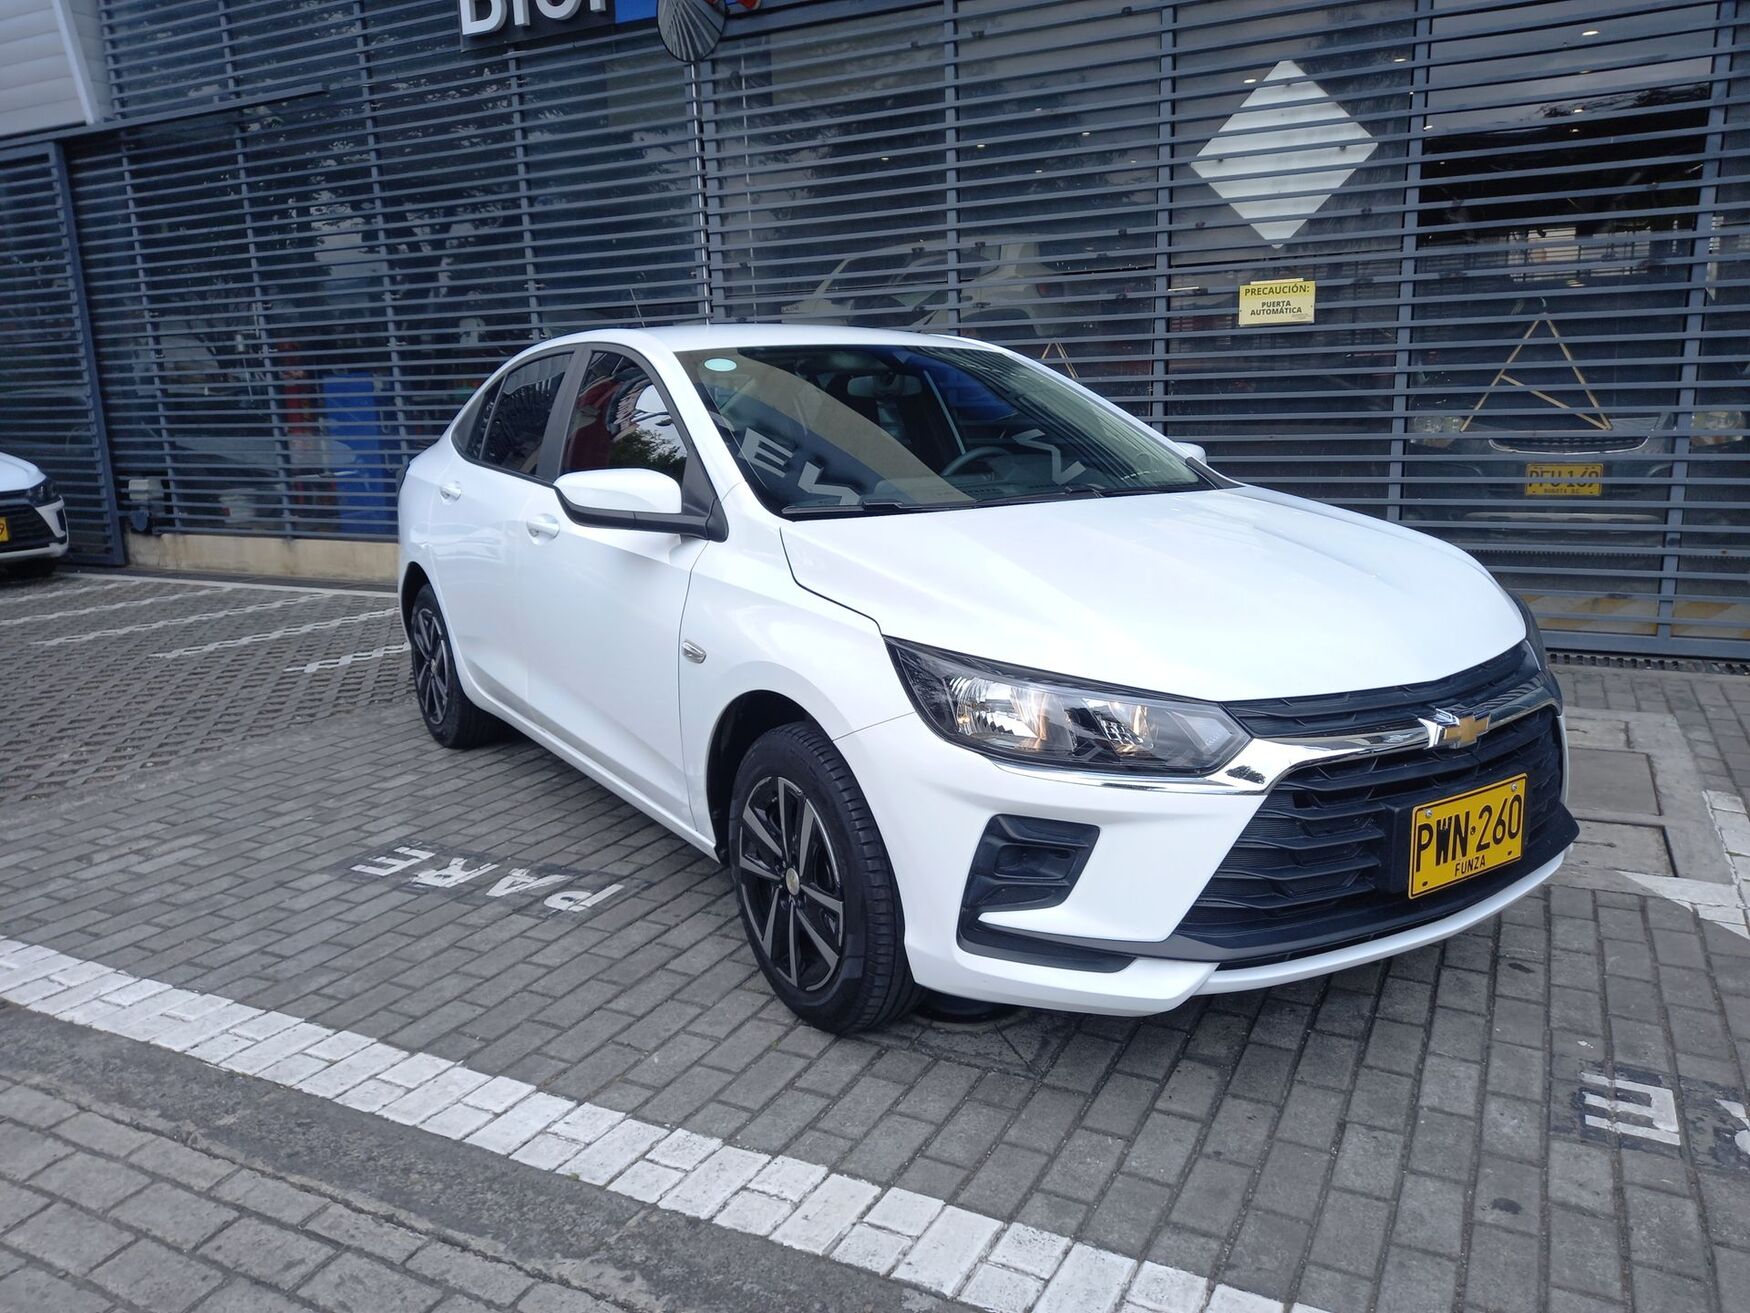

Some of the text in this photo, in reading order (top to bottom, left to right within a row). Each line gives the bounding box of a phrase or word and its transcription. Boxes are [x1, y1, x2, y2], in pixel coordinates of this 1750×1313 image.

[1244, 283, 1310, 296] PRECAUCIÓN:
[1261, 300, 1291, 308] PUERTA
[1250, 306, 1302, 316] AUTOMÁTICA
[1454, 854, 1486, 877] FUNZA
[350, 845, 625, 912] PARE
